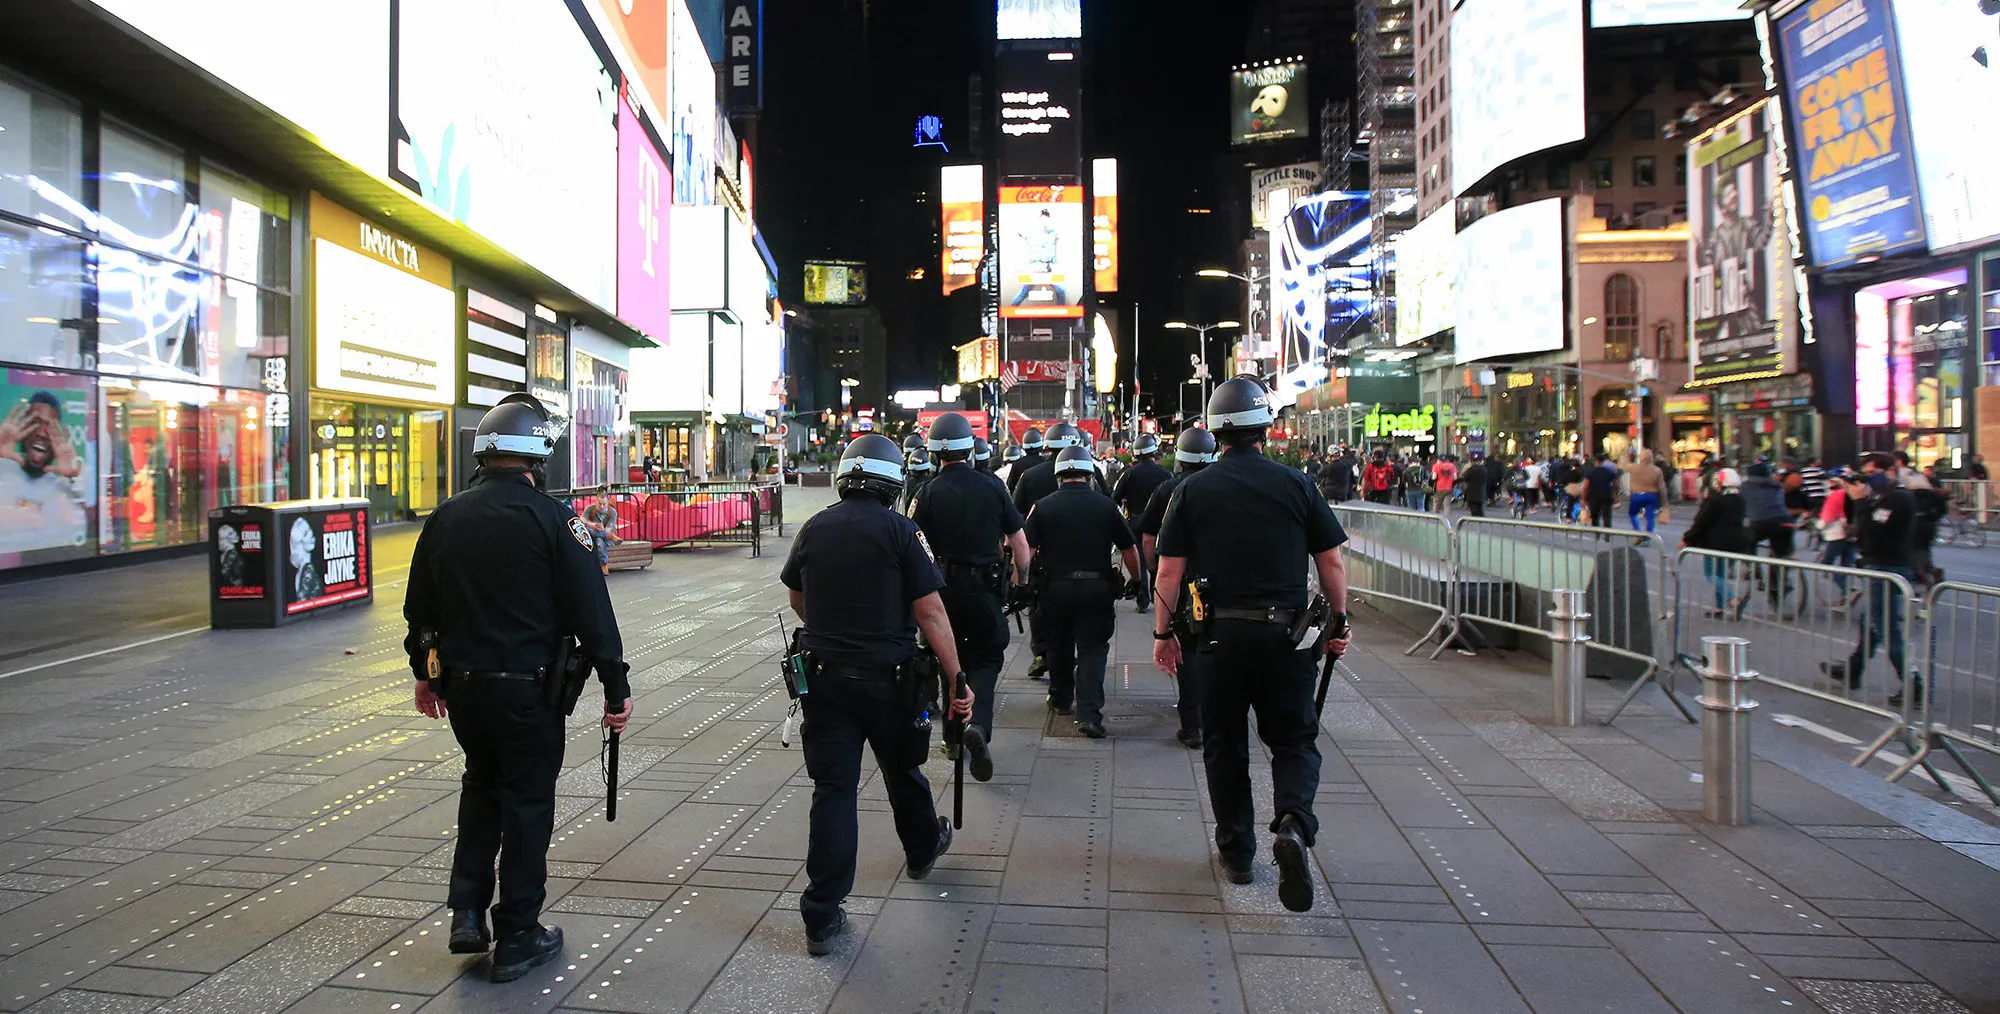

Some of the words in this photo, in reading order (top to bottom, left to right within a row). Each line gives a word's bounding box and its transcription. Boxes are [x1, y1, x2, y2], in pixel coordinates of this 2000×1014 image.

[1798, 47, 1889, 117] COME
[1809, 114, 1897, 182] AWAY
[1258, 168, 1291, 189] LITTLE
[1292, 168, 1317, 181] SHOP
[360, 222, 420, 273] INVICTA
[1380, 404, 1435, 437] pelé
[241, 530, 261, 541] ERIKA
[241, 540, 262, 549] JAYNE
[323, 530, 355, 560] ERIKA
[324, 556, 356, 585] JAYNE
